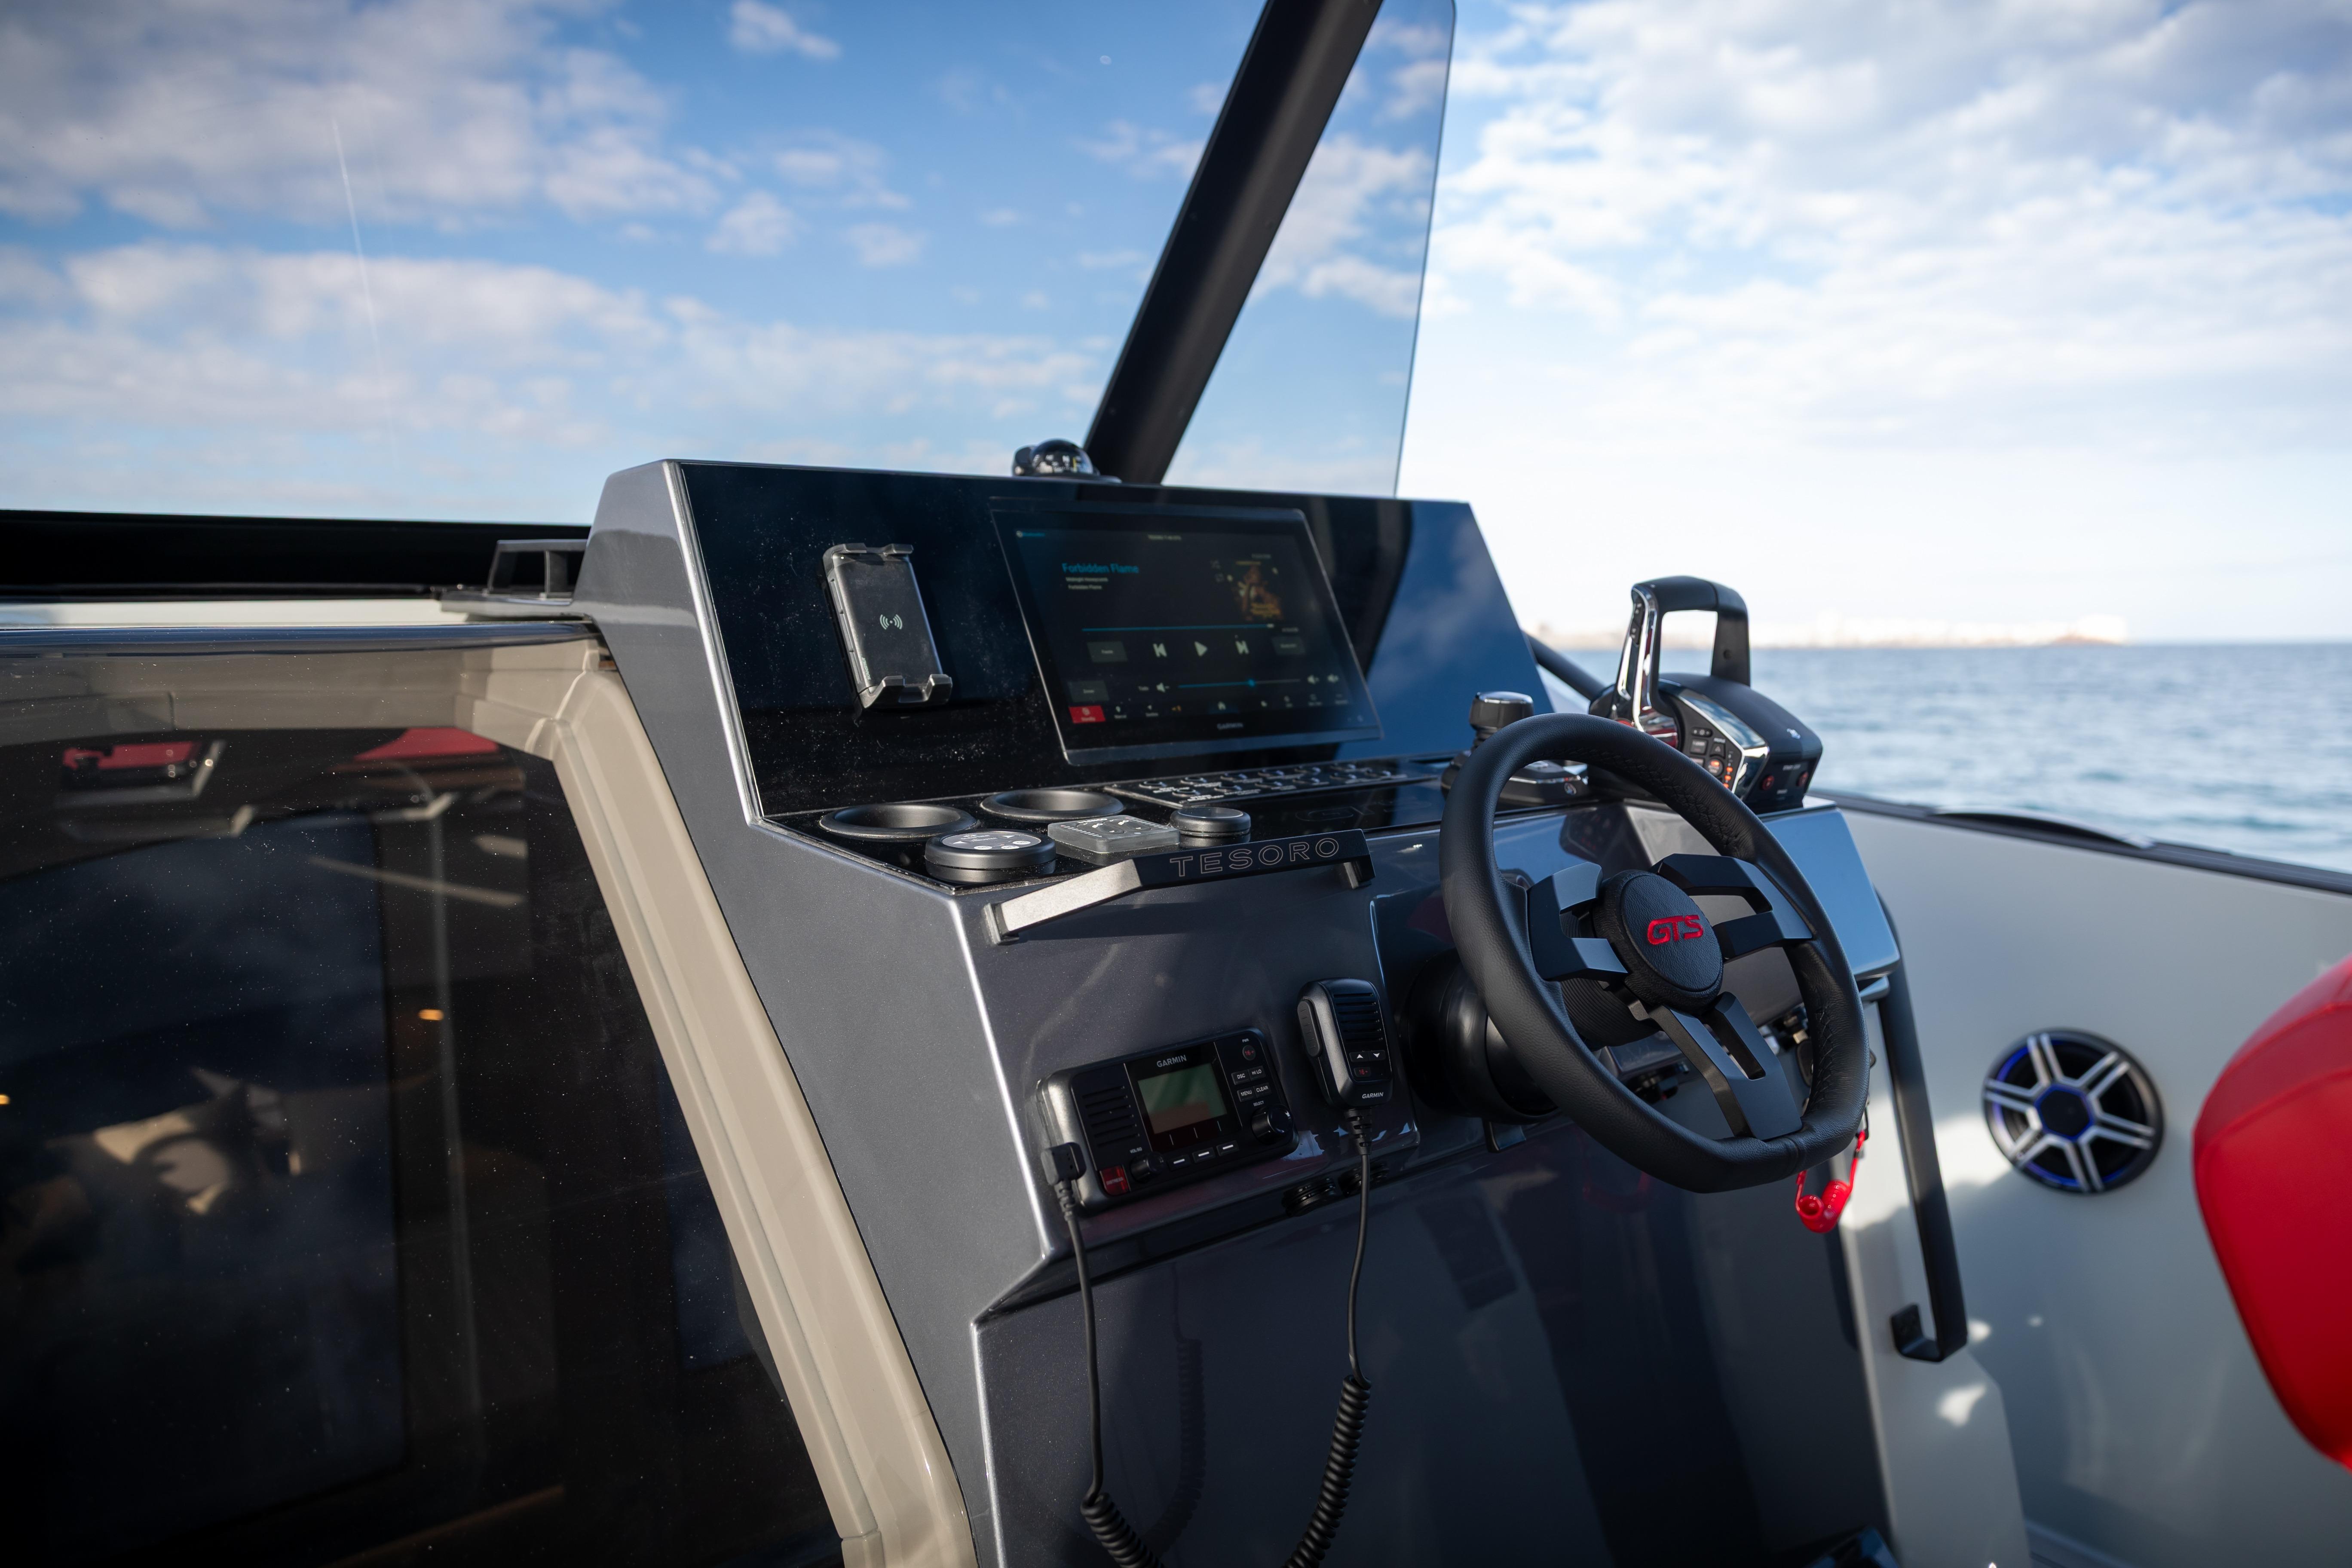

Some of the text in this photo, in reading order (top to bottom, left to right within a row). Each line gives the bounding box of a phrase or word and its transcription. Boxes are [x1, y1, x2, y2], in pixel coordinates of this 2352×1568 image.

[1061, 563, 1139, 573] Forbidden Flame
[1170, 838, 1339, 877] TESORO
[1647, 914, 1703, 945] GTS
[1156, 1054, 1187, 1068] GARMIN
